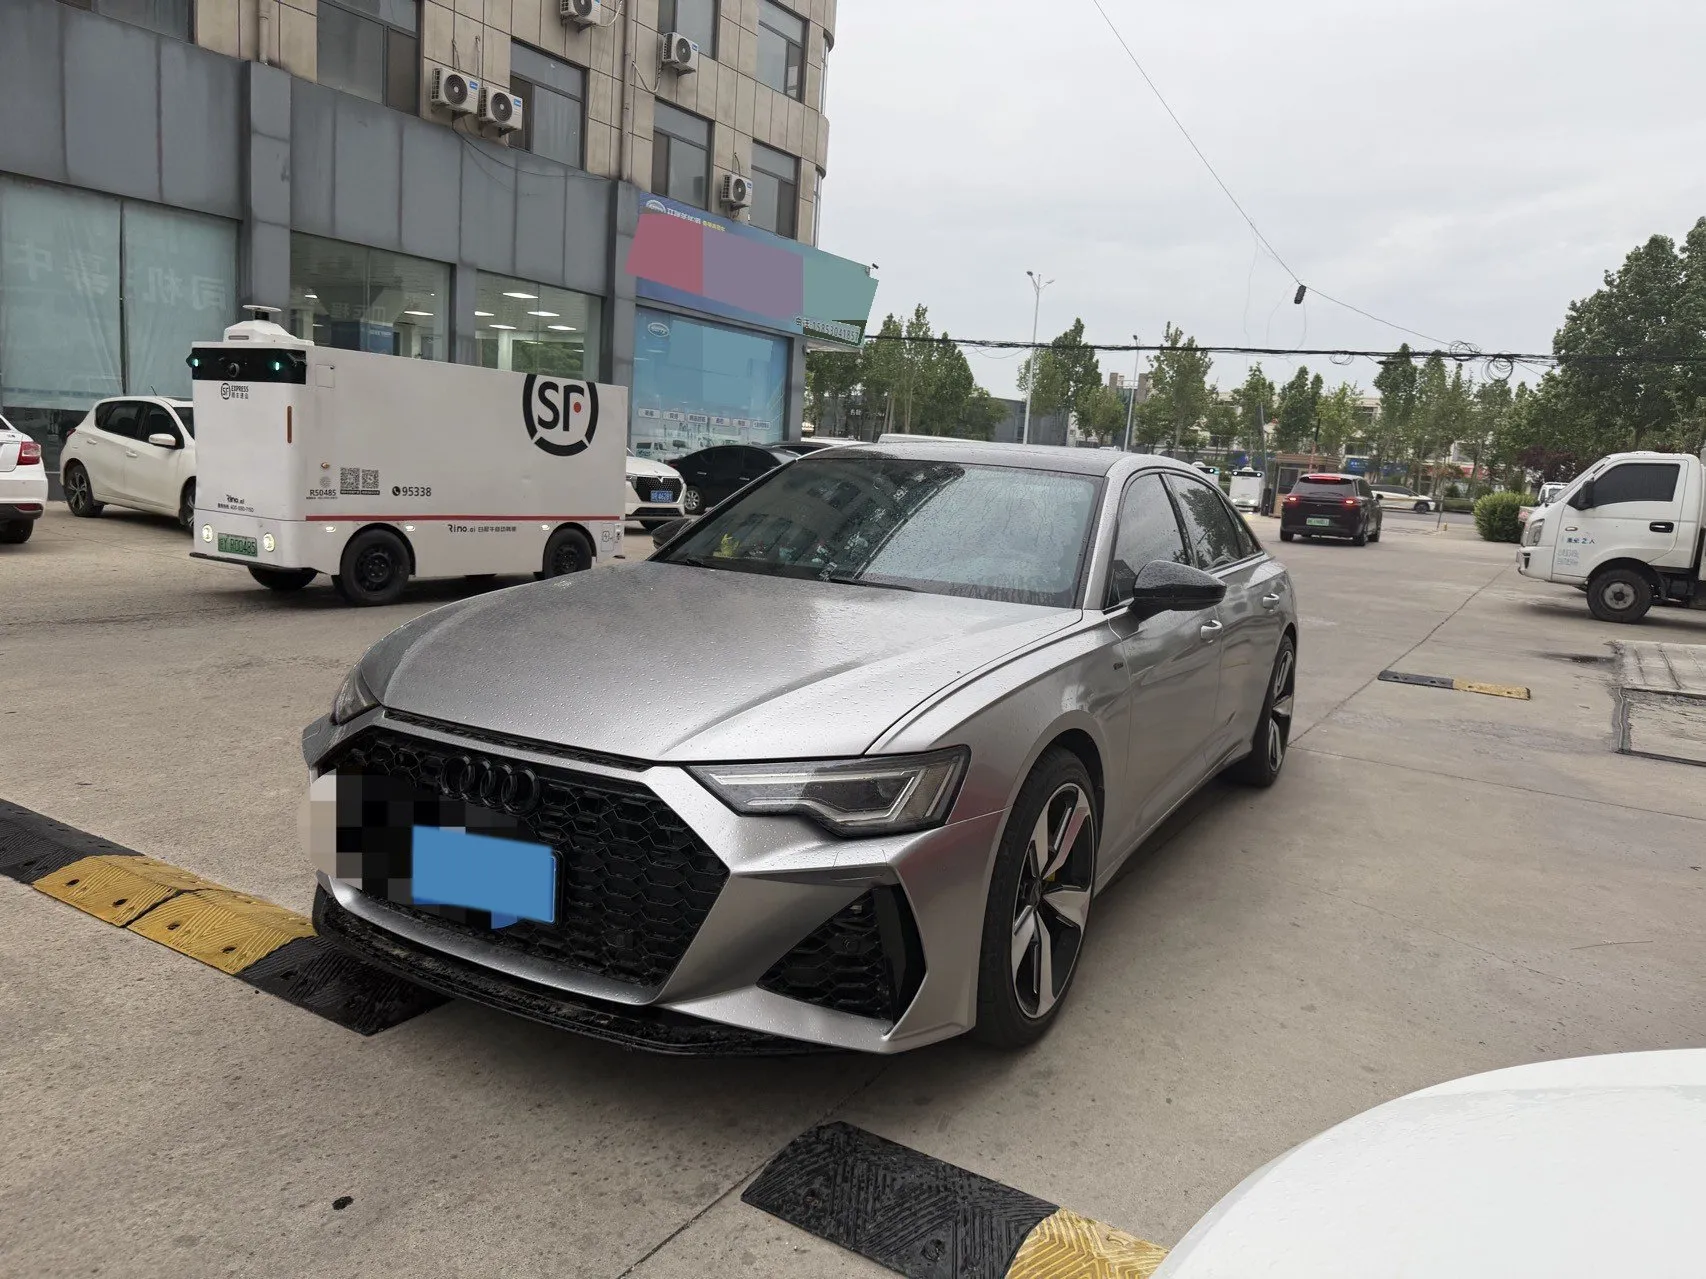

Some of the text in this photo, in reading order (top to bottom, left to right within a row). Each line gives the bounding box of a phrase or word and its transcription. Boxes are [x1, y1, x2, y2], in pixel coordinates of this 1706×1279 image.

[538, 381, 584, 431] SF
[309, 489, 336, 497] R50485
[402, 487, 432, 497] 95338
